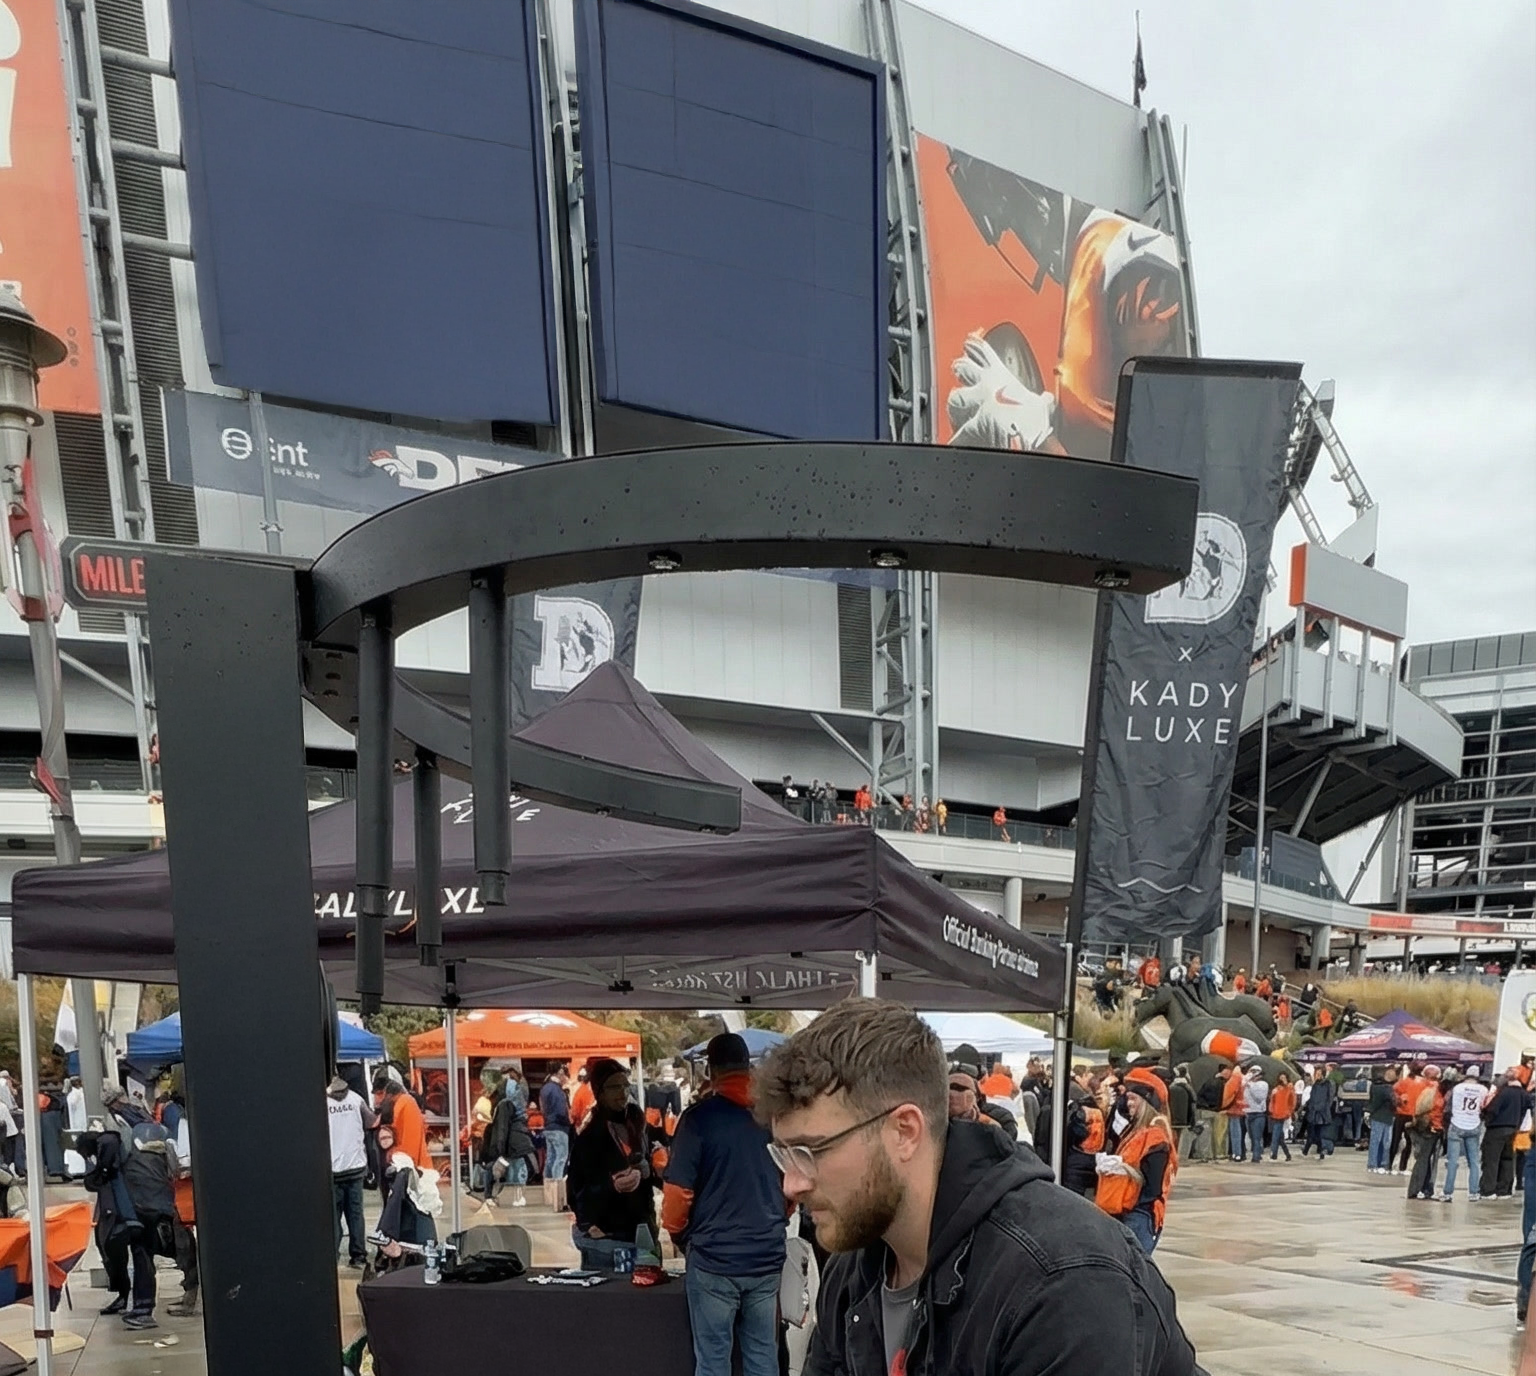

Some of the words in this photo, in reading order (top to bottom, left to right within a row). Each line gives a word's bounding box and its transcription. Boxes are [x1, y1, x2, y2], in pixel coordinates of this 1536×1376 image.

[80, 553, 146, 595] MILE
[1129, 680, 1238, 708] KADY
[1126, 716, 1231, 744] LUXE
